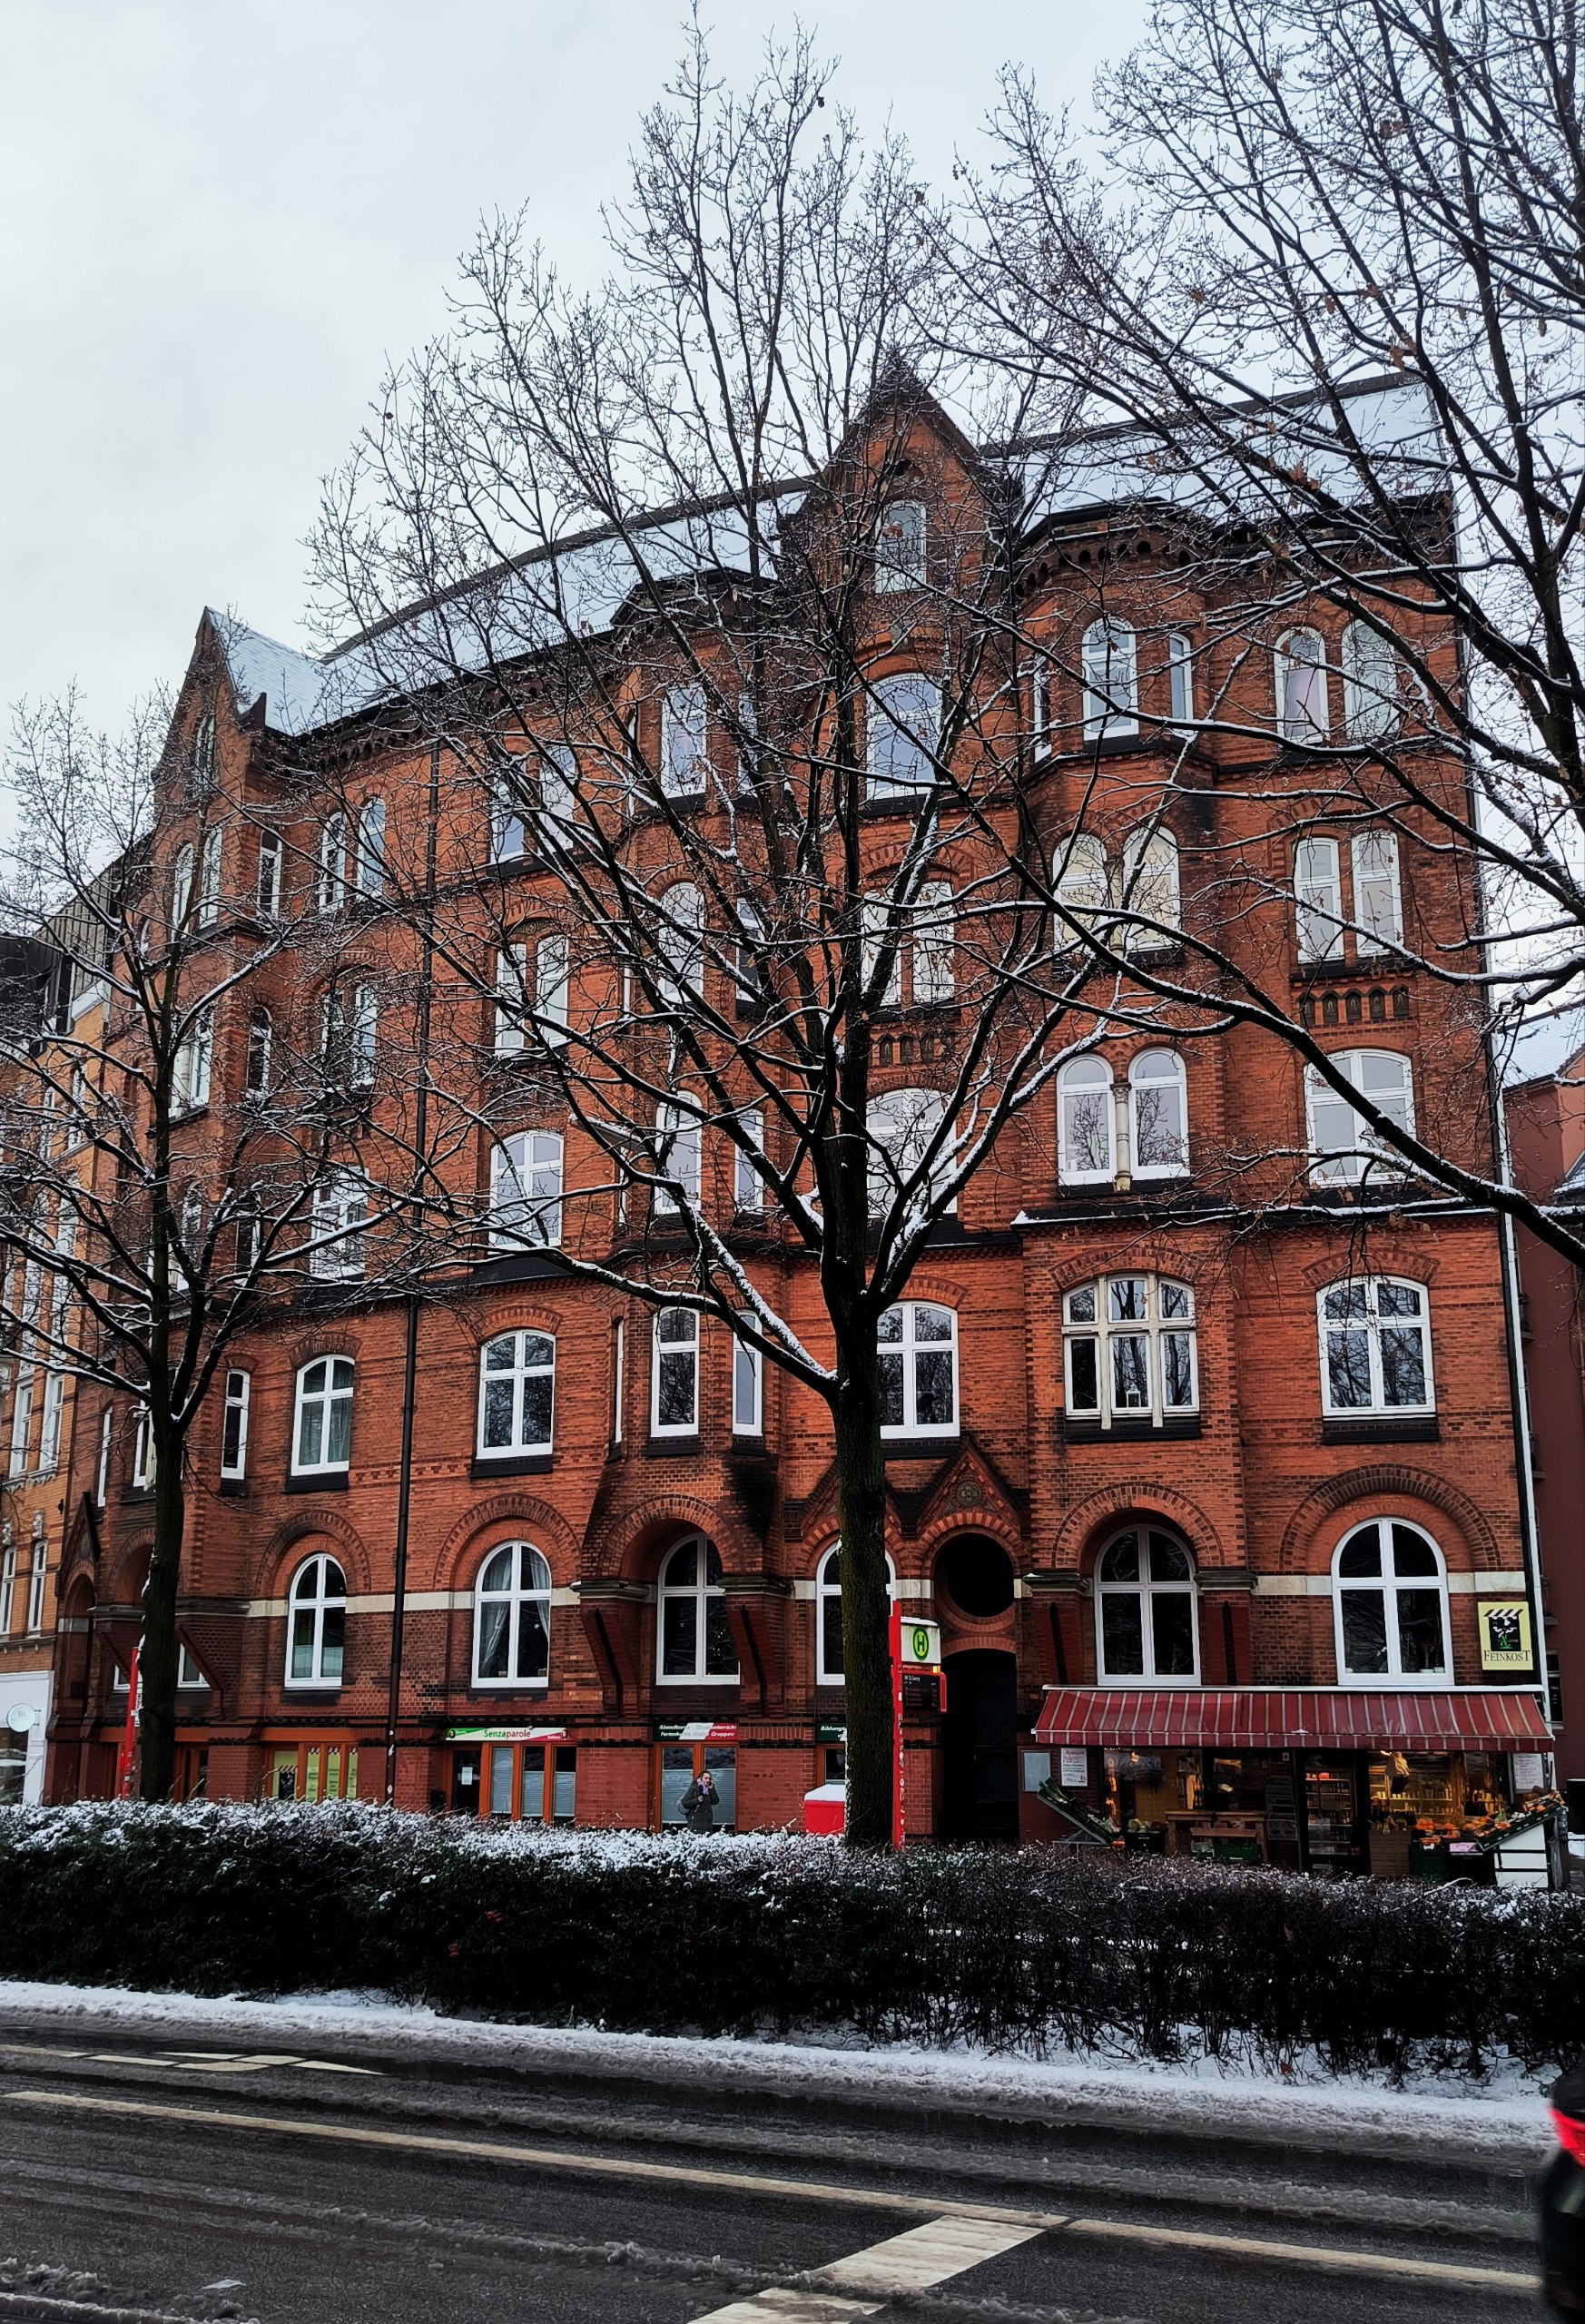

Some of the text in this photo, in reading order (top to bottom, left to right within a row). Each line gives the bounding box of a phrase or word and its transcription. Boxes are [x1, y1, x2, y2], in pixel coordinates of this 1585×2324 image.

[917, 1634, 925, 1652] H
[1483, 1649, 1531, 1662] FEINKOST
[484, 1729, 531, 1740] Senzaparole
